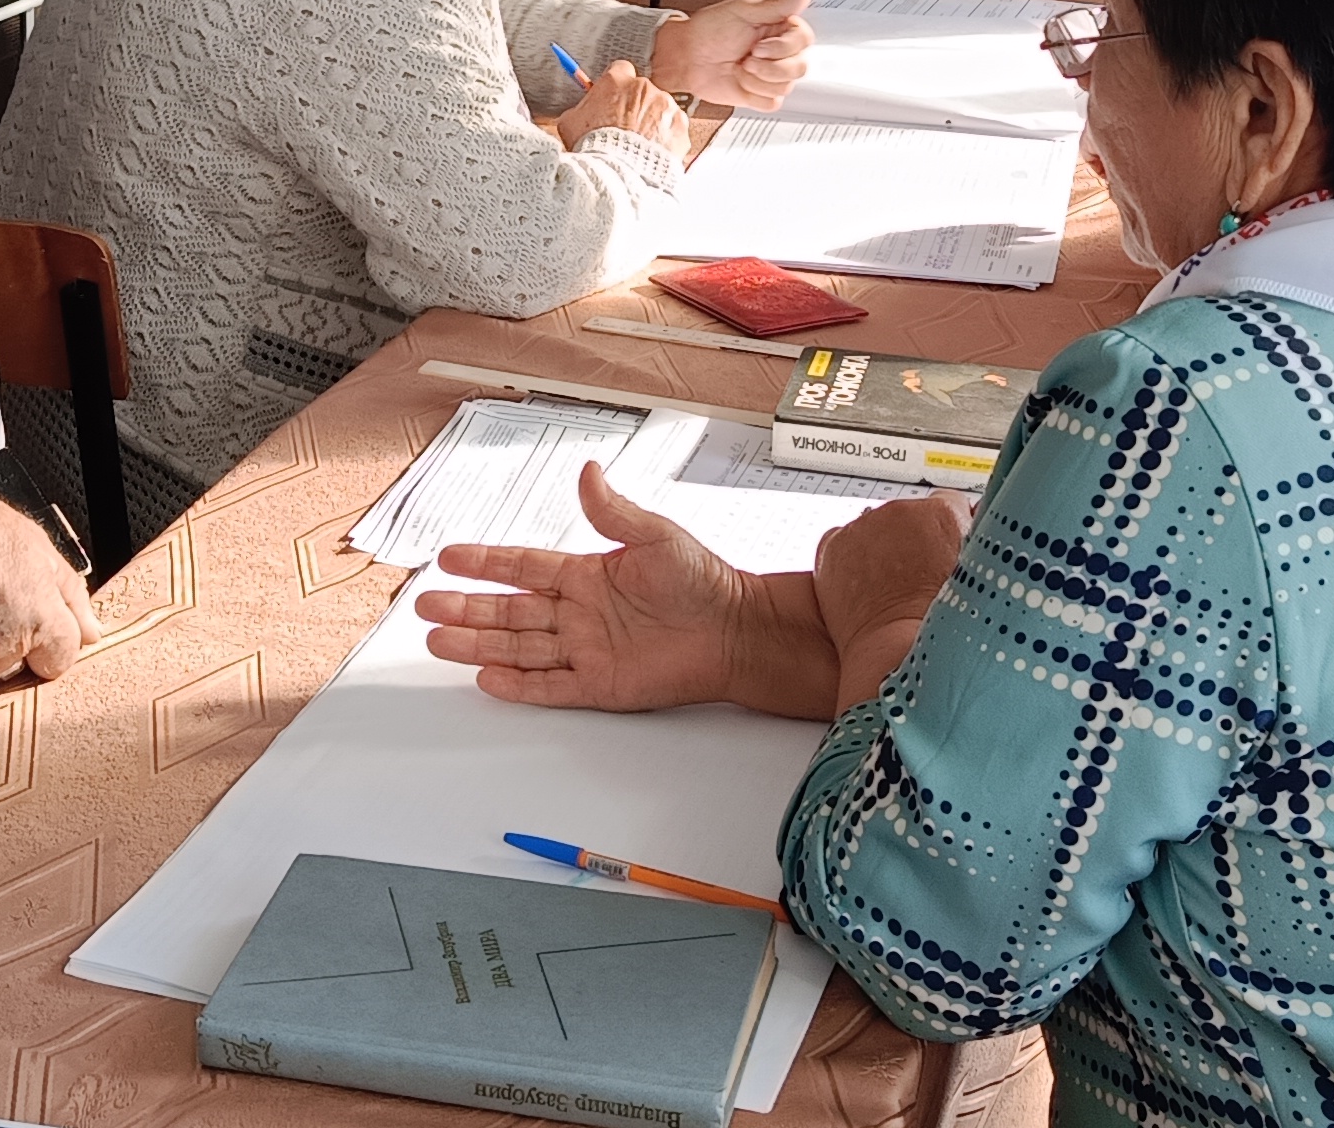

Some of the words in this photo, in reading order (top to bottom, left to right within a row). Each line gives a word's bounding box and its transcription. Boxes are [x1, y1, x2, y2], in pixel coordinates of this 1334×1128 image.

[794, 381, 829, 409] ГРОБ
[826, 355, 871, 407] ГОНКОНГА
[791, 435, 862, 457] ГОНКОНГА
[872, 446, 907, 462] ГРОБ
[435, 921, 457, 960] Зазубрин
[478, 928, 504, 962] МИРА
[449, 960, 471, 1004] Владимир
[490, 963, 516, 988] ДВА
[473, 1082, 571, 1113] Зазубрин
[575, 1093, 683, 1128] Владимир
